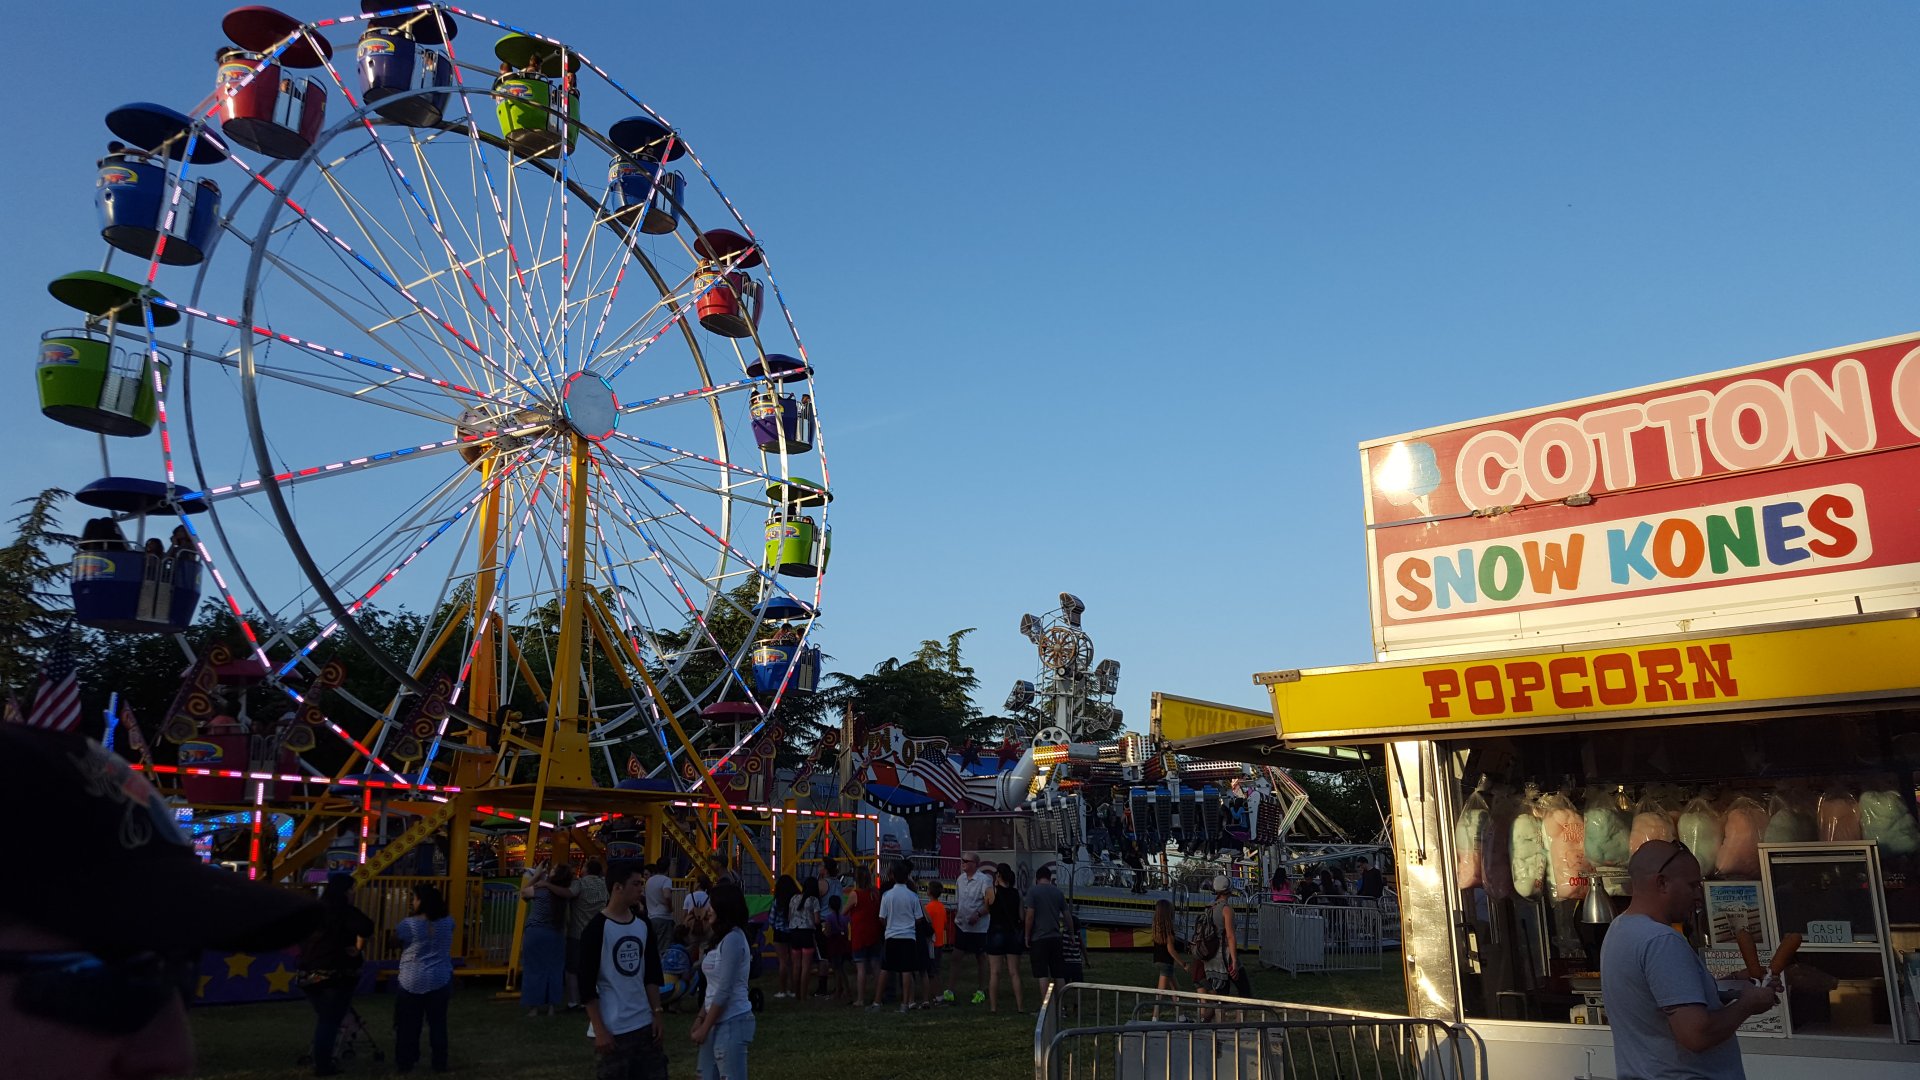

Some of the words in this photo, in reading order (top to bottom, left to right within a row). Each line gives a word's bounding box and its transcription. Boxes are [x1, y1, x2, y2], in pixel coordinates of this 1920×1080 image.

[1455, 358, 1877, 513] COTTON
[1396, 532, 1585, 612] SNOW
[1606, 494, 1857, 585] KONES
[1423, 643, 1738, 718] POPCORN
[1812, 923, 1843, 934] CASH
[1813, 934, 1843, 943] ONLY
